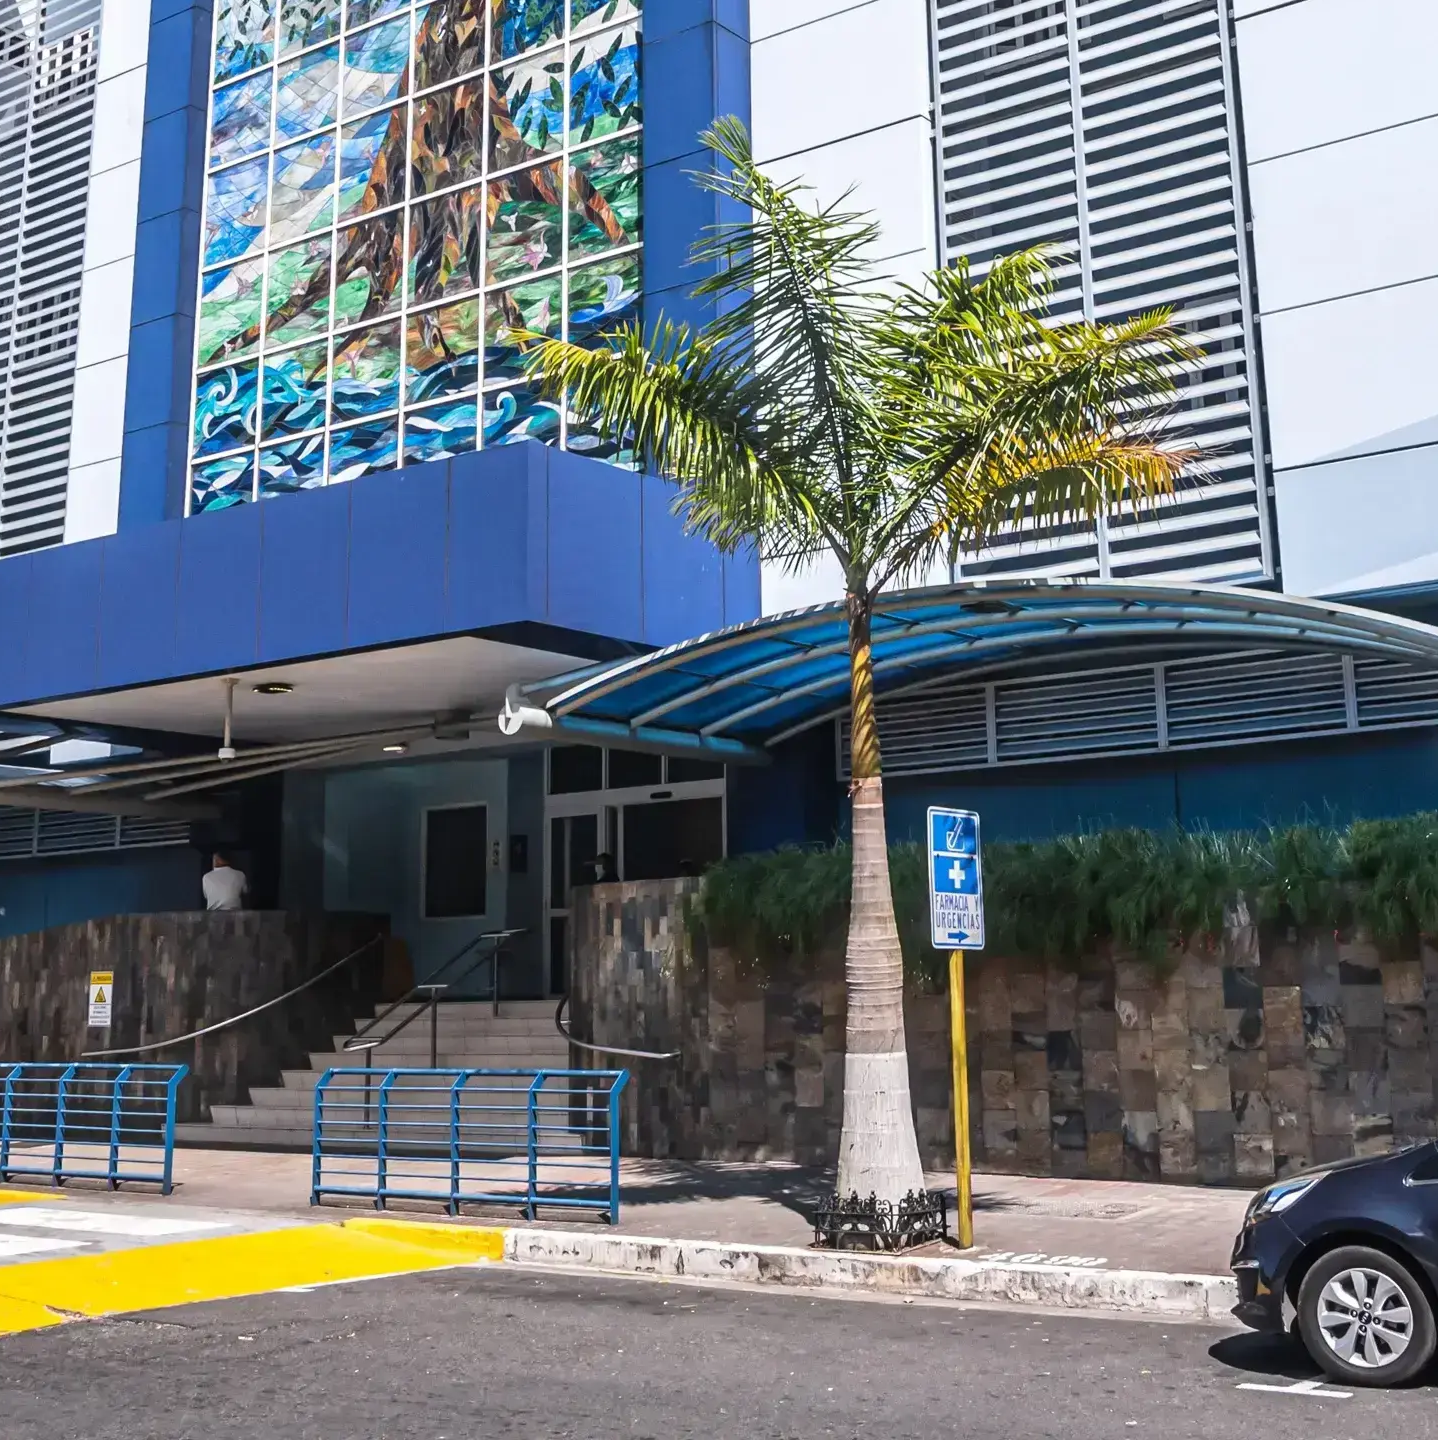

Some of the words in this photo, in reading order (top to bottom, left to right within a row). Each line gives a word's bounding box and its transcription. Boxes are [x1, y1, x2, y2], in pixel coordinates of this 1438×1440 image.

[935, 893, 969, 911] FARMACIA
[974, 897, 979, 911] Y
[936, 911, 980, 929] URGENCIAS
